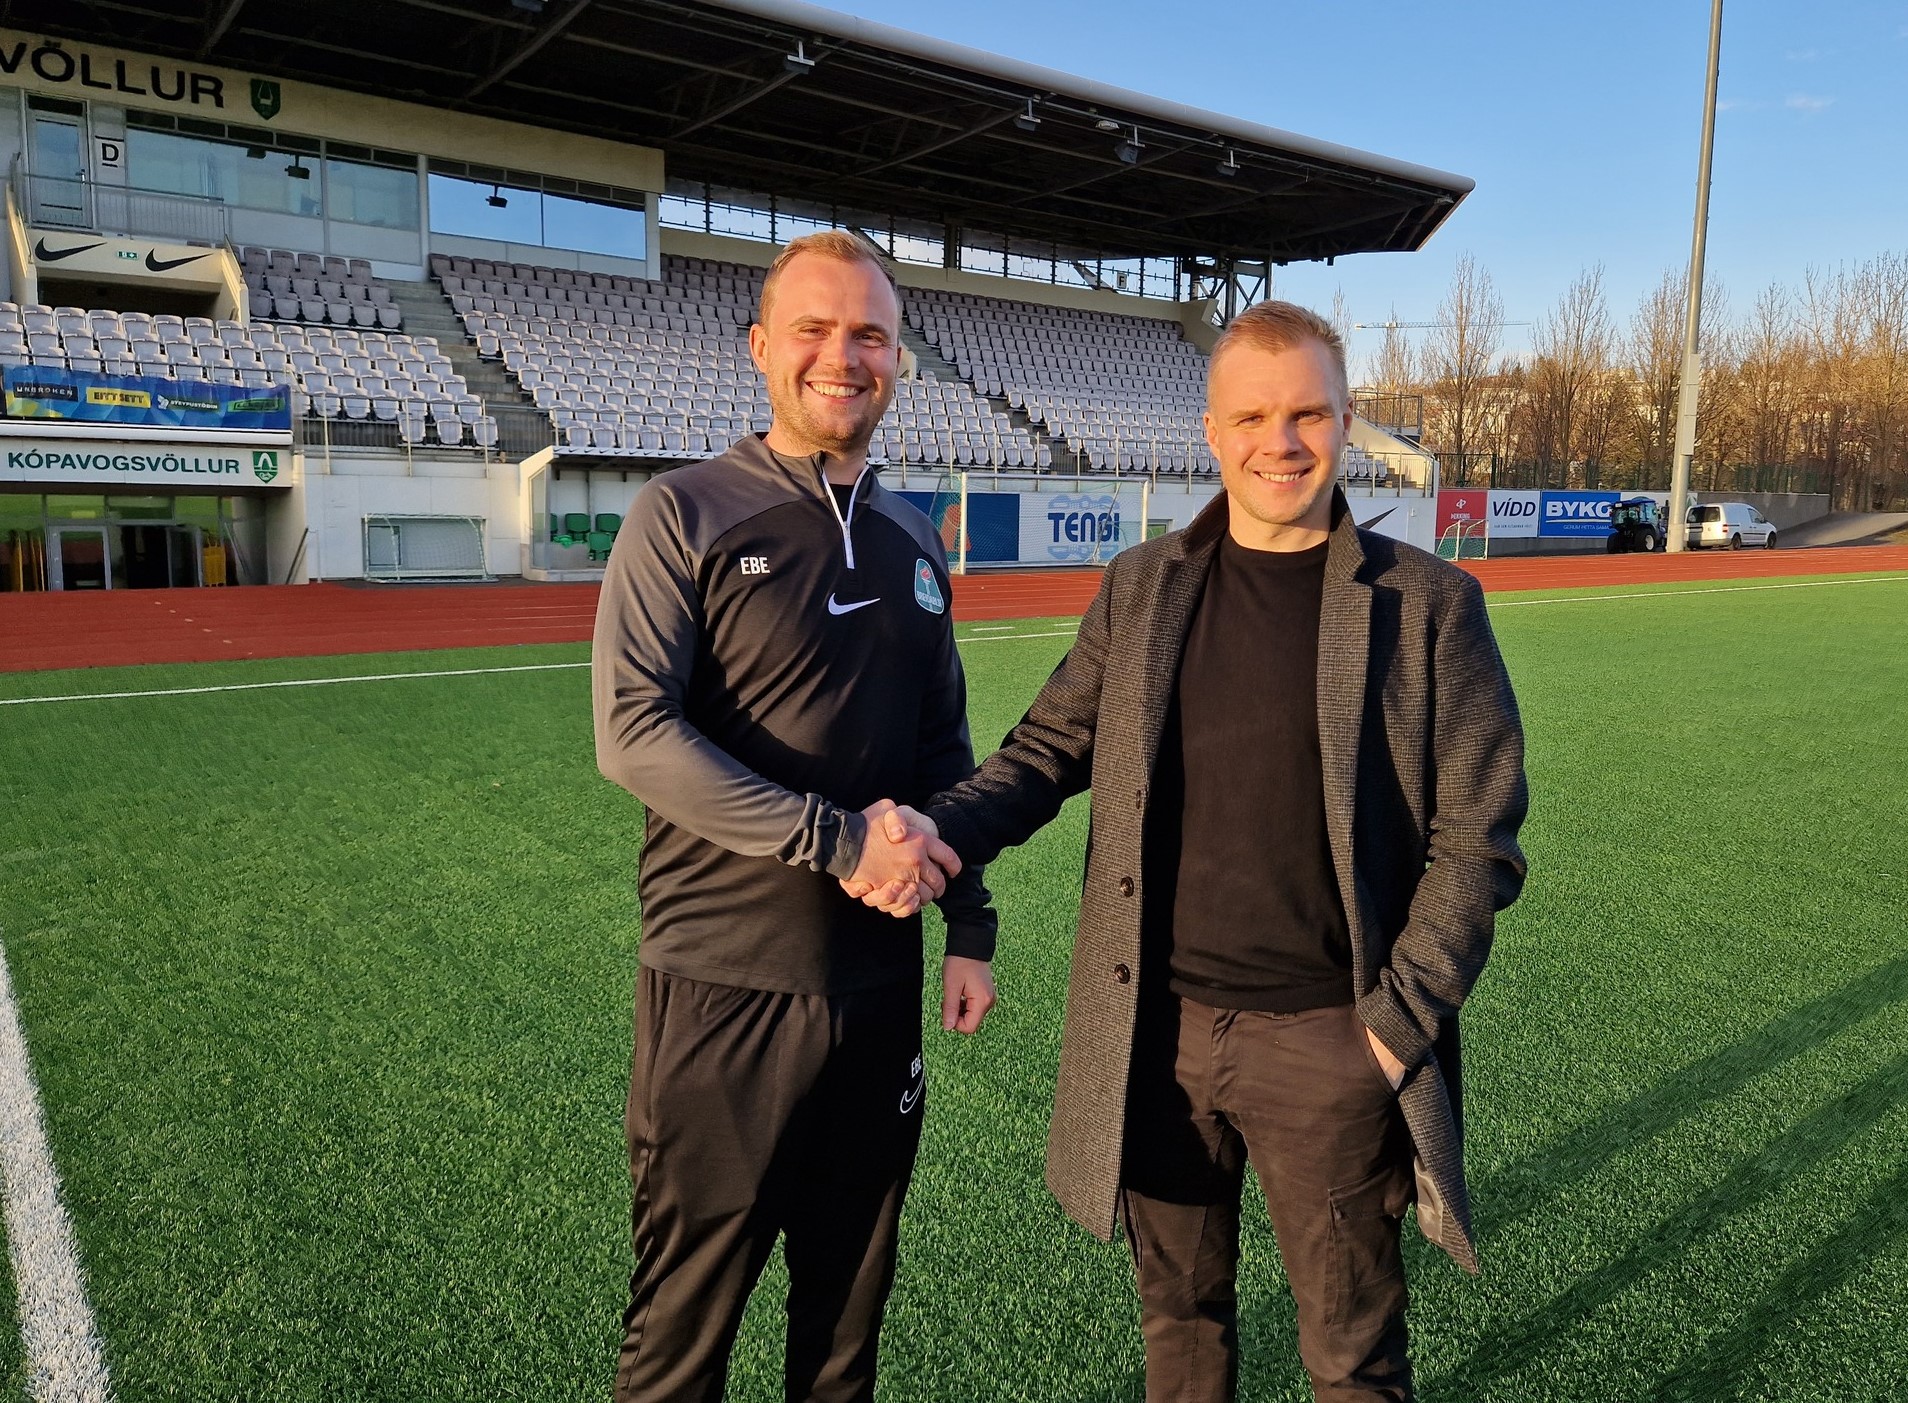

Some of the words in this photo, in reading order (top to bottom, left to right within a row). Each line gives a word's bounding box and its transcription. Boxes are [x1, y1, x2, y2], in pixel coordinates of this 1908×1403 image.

[101, 142, 119, 162] D
[1119, 275, 1125, 286] F
[16, 386, 73, 397] UNBROKEN
[119, 392, 145, 404] SETT
[8, 448, 240, 474] KÓPAVOGSVÖLLUR
[1493, 497, 1536, 517] VÍDD
[1048, 512, 1120, 543] TENGI
[740, 556, 770, 575] EBE
